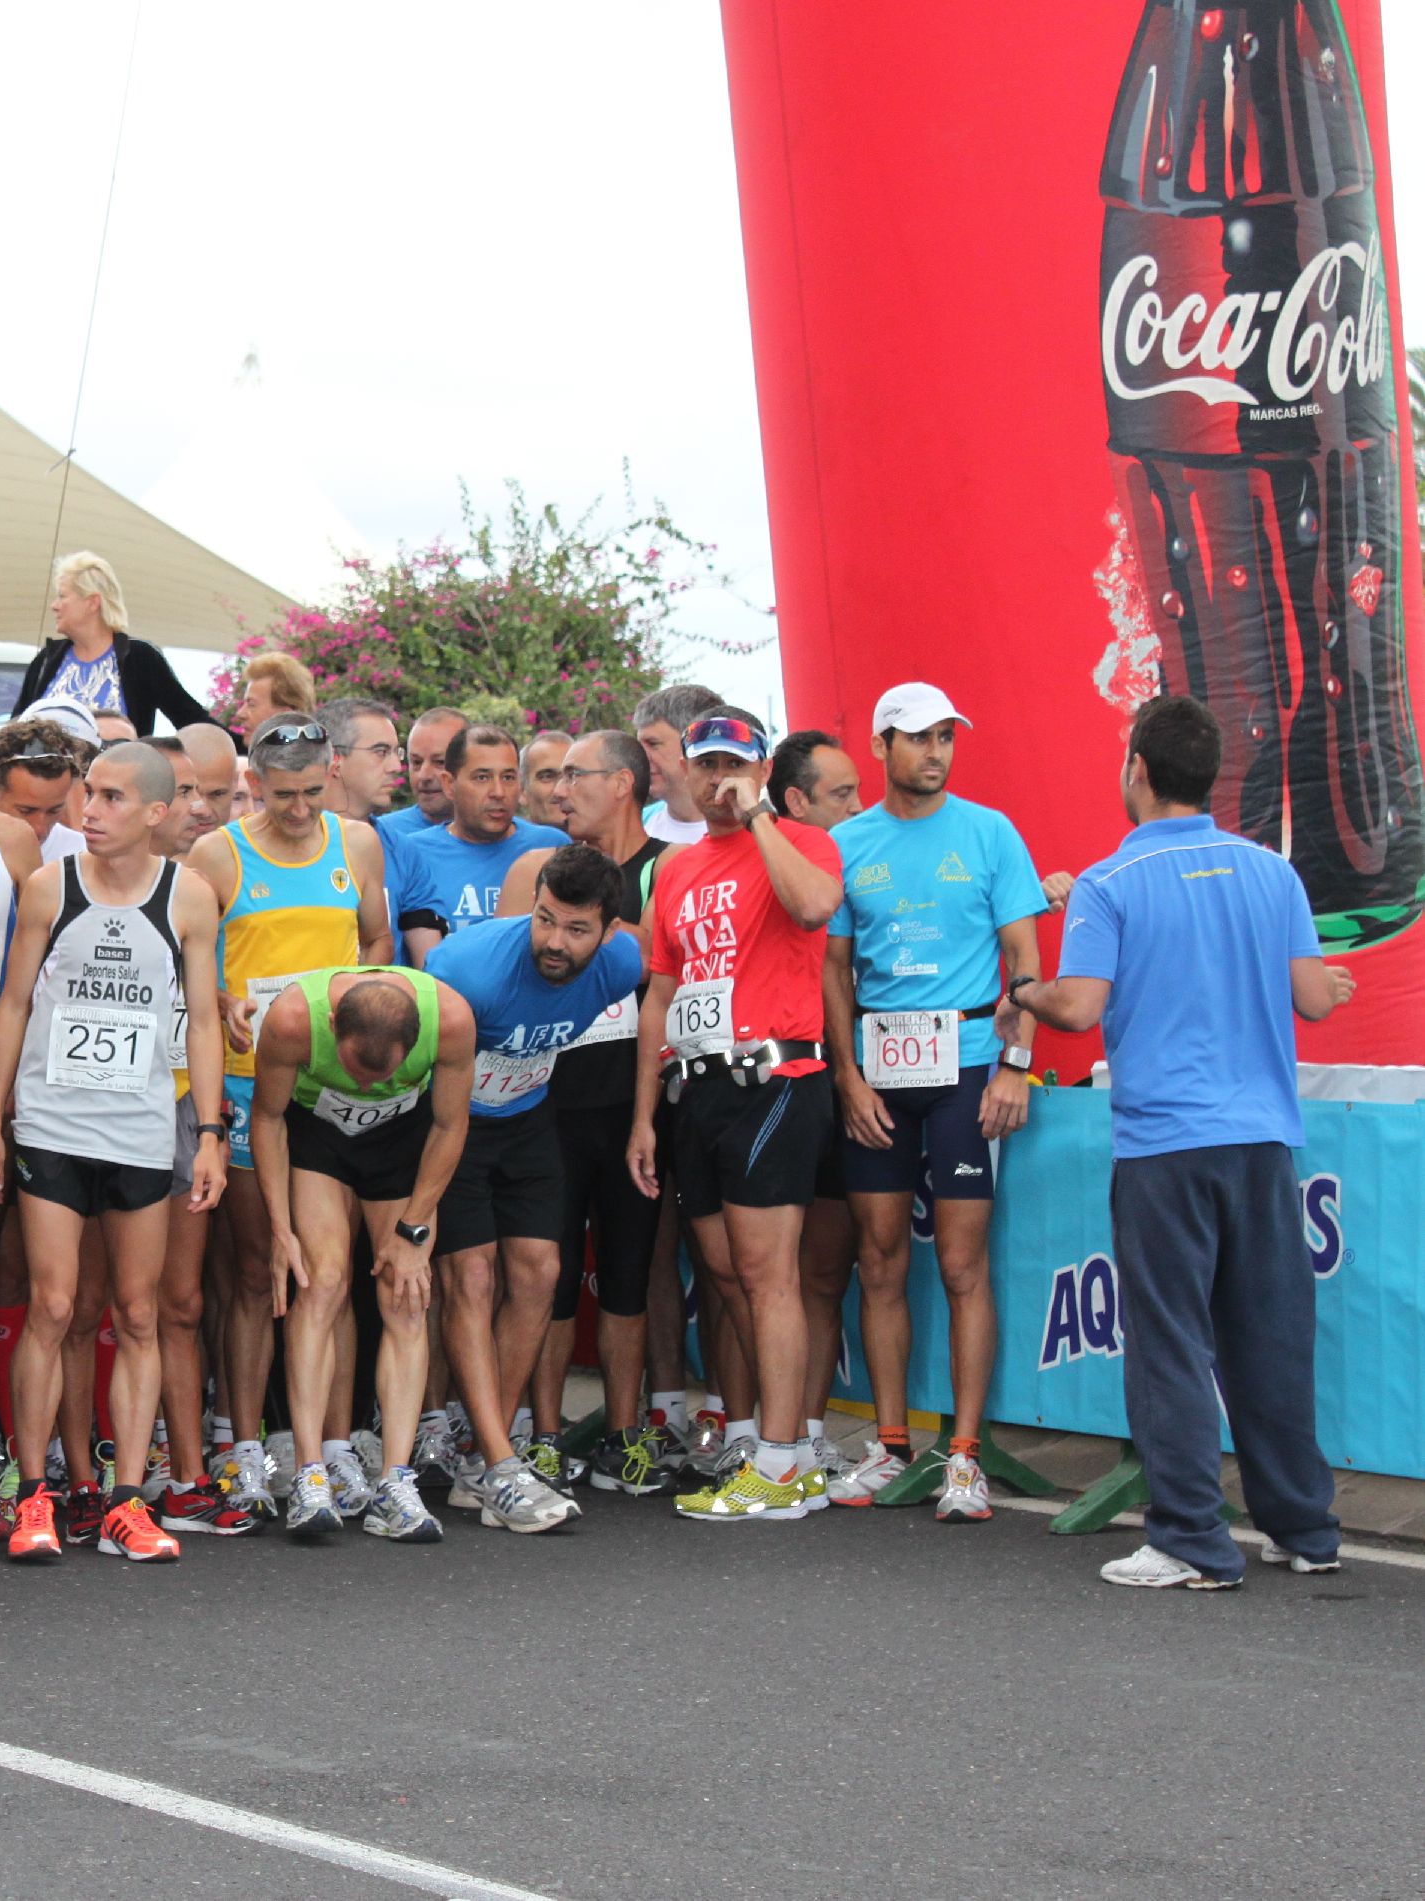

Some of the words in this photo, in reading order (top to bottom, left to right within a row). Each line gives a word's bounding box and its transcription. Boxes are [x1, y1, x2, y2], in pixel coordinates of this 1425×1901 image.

[1102, 231, 1385, 405] Coca-Cola
[1249, 405, 1298, 421] MARCAS
[1299, 404, 1323, 417] REG.
[452, 883, 501, 916] AF
[675, 880, 738, 927] AFR
[82, 963, 116, 980] Deportes
[118, 965, 141, 980] Salud
[67, 979, 153, 1005] TASAIGO
[676, 997, 721, 1036] 163
[871, 1014, 931, 1026] CARRERA
[494, 1020, 574, 1050] AFR
[872, 1024, 929, 1037] PPULAR
[66, 1024, 138, 1065] 251
[882, 1036, 938, 1067] 601
[480, 1067, 549, 1093] 1122
[331, 1103, 402, 1126] 404
[229, 1130, 249, 1144] Caj
